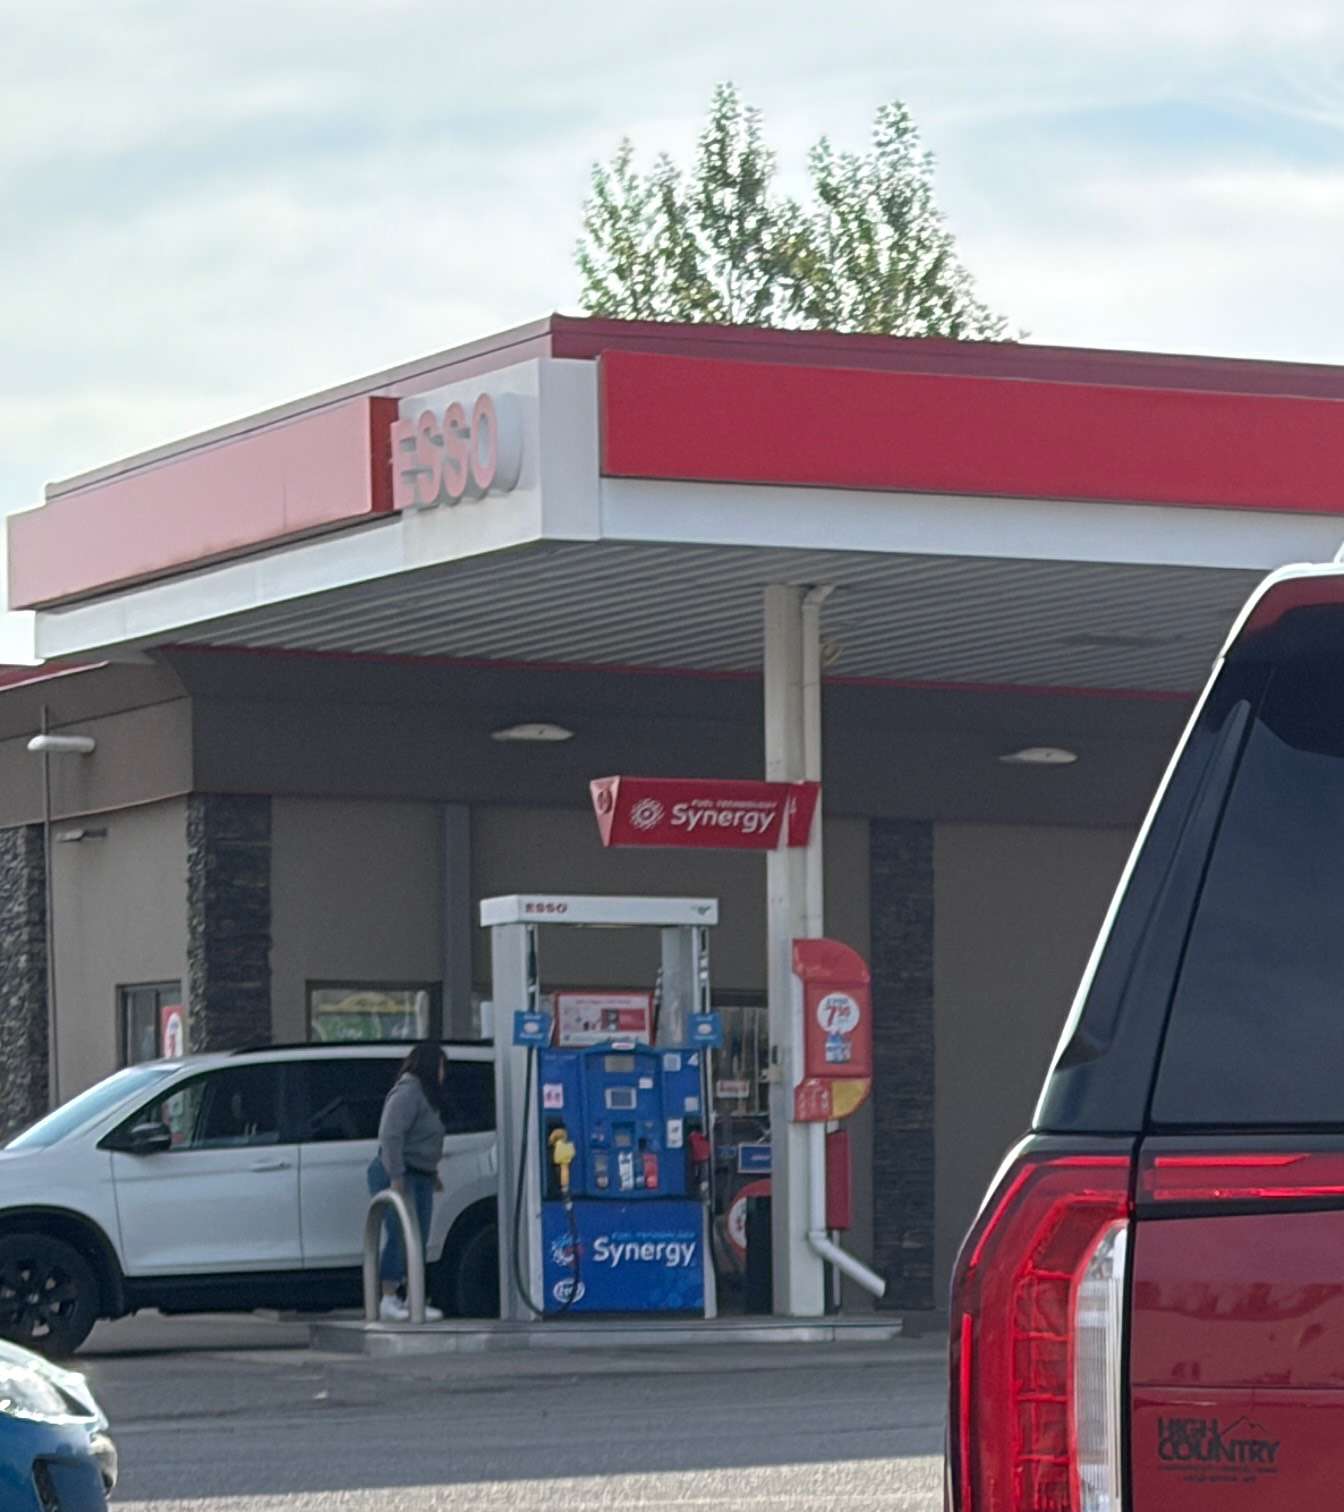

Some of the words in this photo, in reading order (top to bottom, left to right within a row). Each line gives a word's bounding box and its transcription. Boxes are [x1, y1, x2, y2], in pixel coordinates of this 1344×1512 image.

[390, 393, 497, 510] ESSO
[670, 803, 775, 834] Synergy
[525, 903, 568, 913] ESSO
[592, 1235, 696, 1268] Synergy
[1157, 1416, 1220, 1439] HIGH
[1157, 1438, 1281, 1463] COUNTRY
